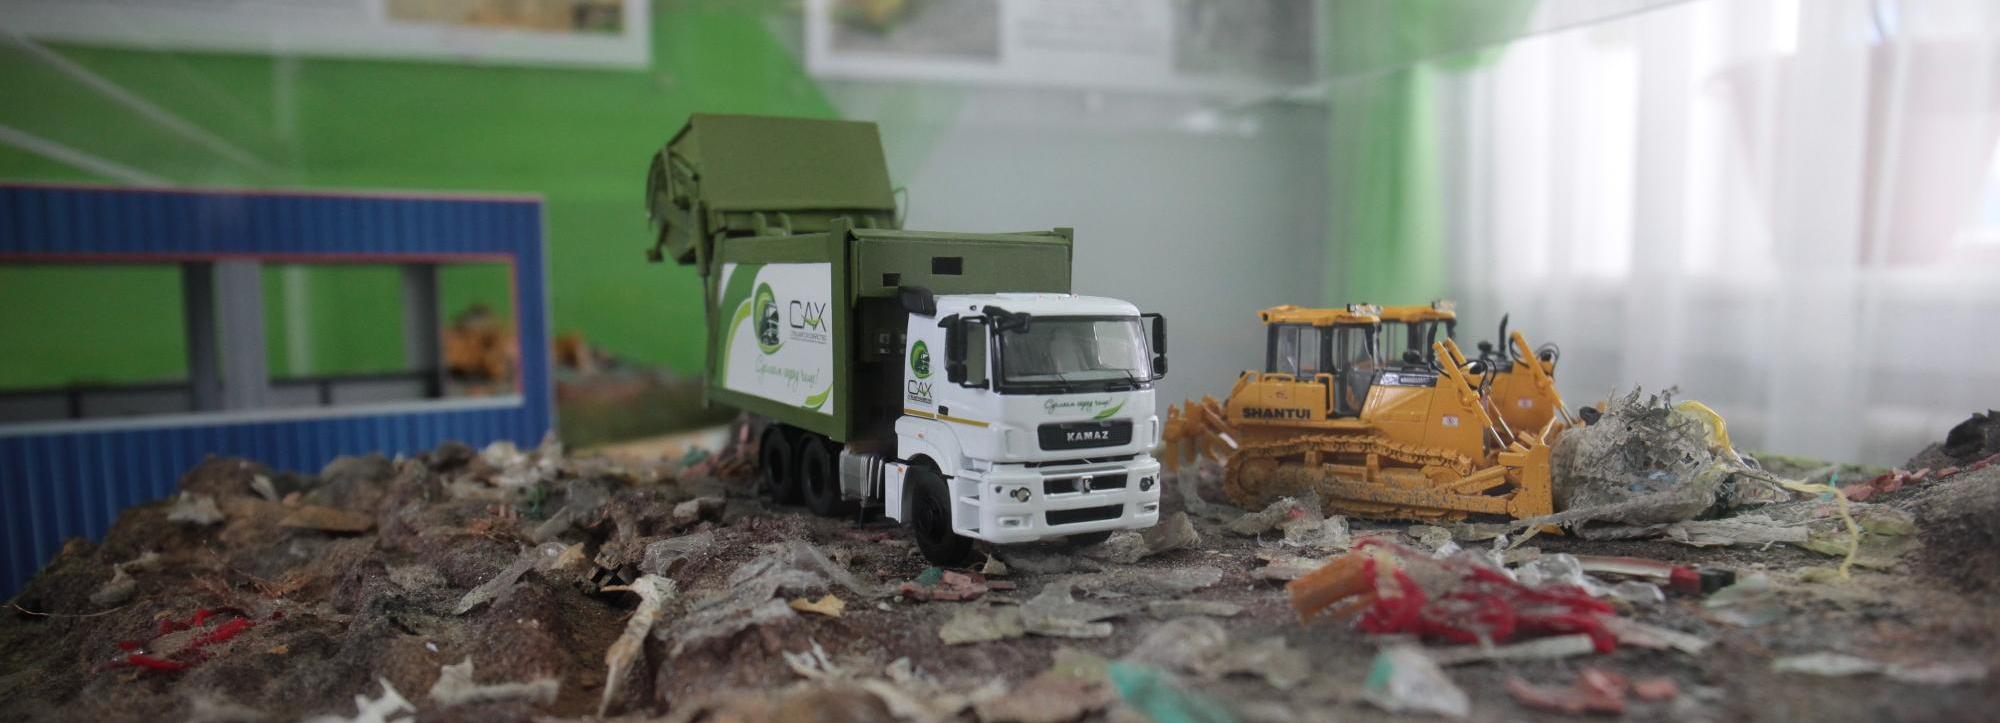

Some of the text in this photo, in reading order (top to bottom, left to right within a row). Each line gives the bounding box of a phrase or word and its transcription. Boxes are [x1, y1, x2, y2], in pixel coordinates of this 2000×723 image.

[788, 300, 827, 333] САХ
[1242, 408, 1311, 419] SHANTUI
[1066, 430, 1109, 442] KAMAZ
